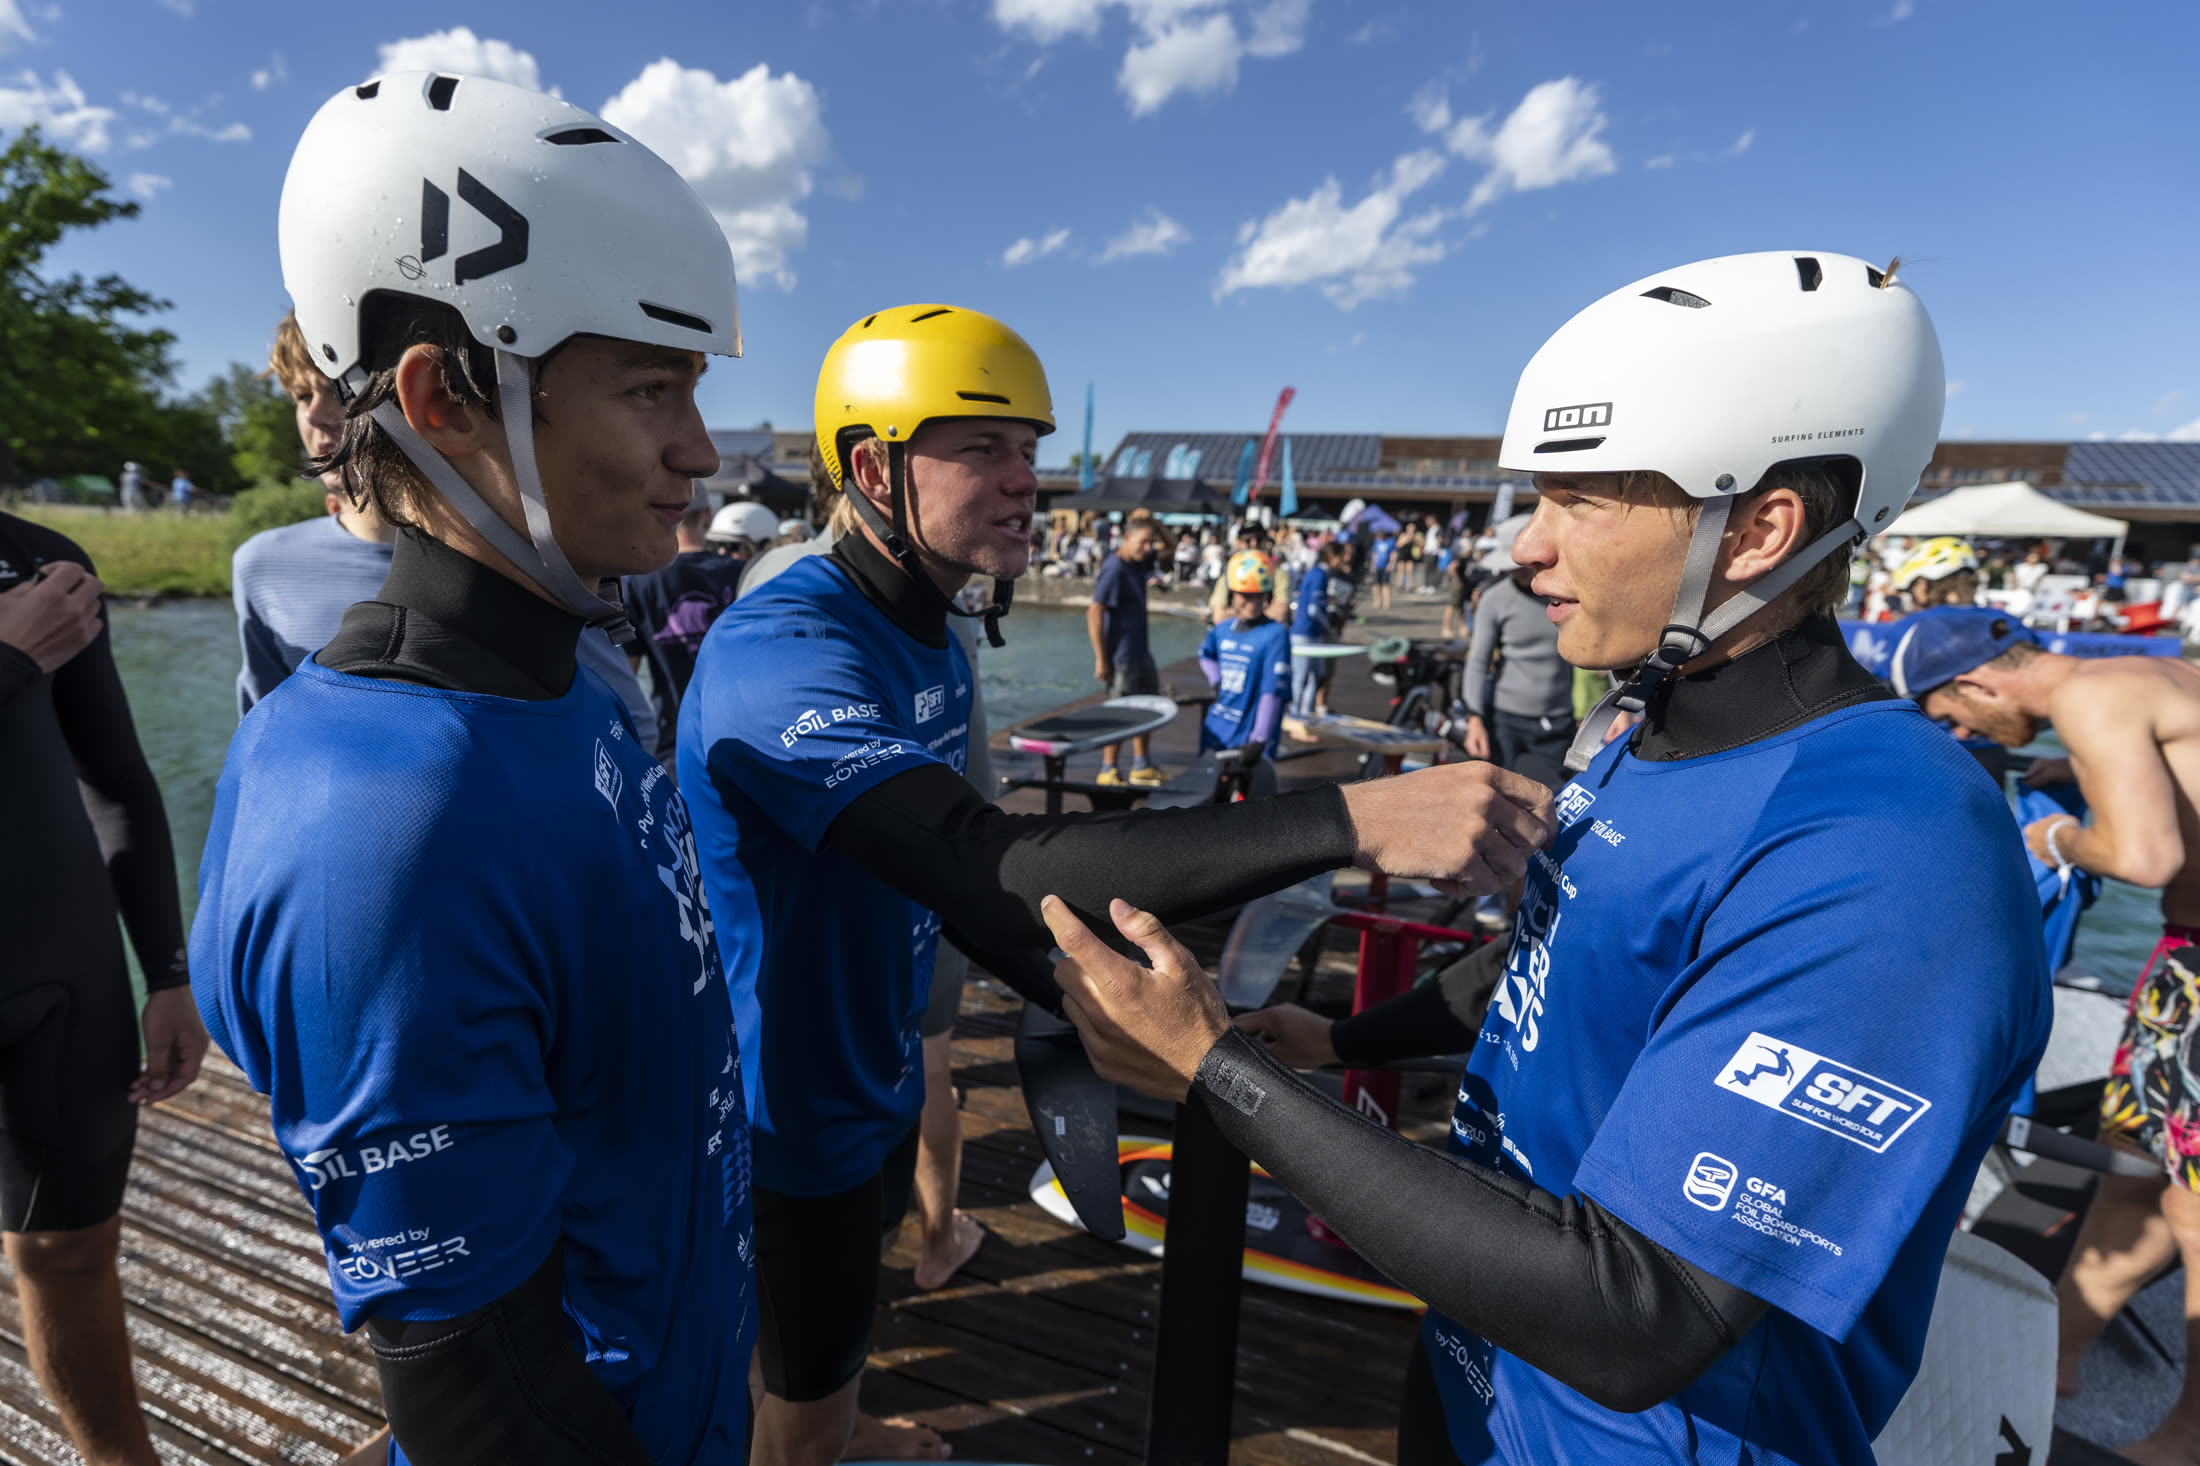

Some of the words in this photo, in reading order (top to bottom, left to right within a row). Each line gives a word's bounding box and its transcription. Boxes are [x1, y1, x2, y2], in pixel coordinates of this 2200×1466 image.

[1772, 432, 1814, 444] SURFING
[1817, 428, 1866, 440] ELEMENTS
[780, 710, 831, 748] EFOIL
[831, 704, 881, 722] BASE
[832, 744, 870, 769] powered
[868, 738, 881, 750] by
[1567, 795, 1590, 815] SFT
[1602, 828, 1626, 847] BASE
[1561, 875, 1577, 900] Cup
[1485, 1032, 1501, 1044] 12
[1805, 1072, 1913, 1126] SFT
[1791, 1098, 1814, 1111] SURF
[1812, 1107, 1833, 1121] FOIL
[1831, 1114, 1861, 1132] WORLD
[1857, 1125, 1884, 1142] TOUR
[359, 1124, 455, 1174] BASE
[1739, 1192, 1784, 1219] GLOBAL
[1746, 1177, 1787, 1206] GFA
[347, 1231, 407, 1254] owered
[407, 1226, 430, 1242] by
[1731, 1212, 1802, 1247] ASSOCIATION
[1735, 1201, 1761, 1220] FOIL
[1761, 1213, 1799, 1234] BOARD
[1797, 1228, 1843, 1257] SPORTS
[1435, 1329, 1450, 1347] by
